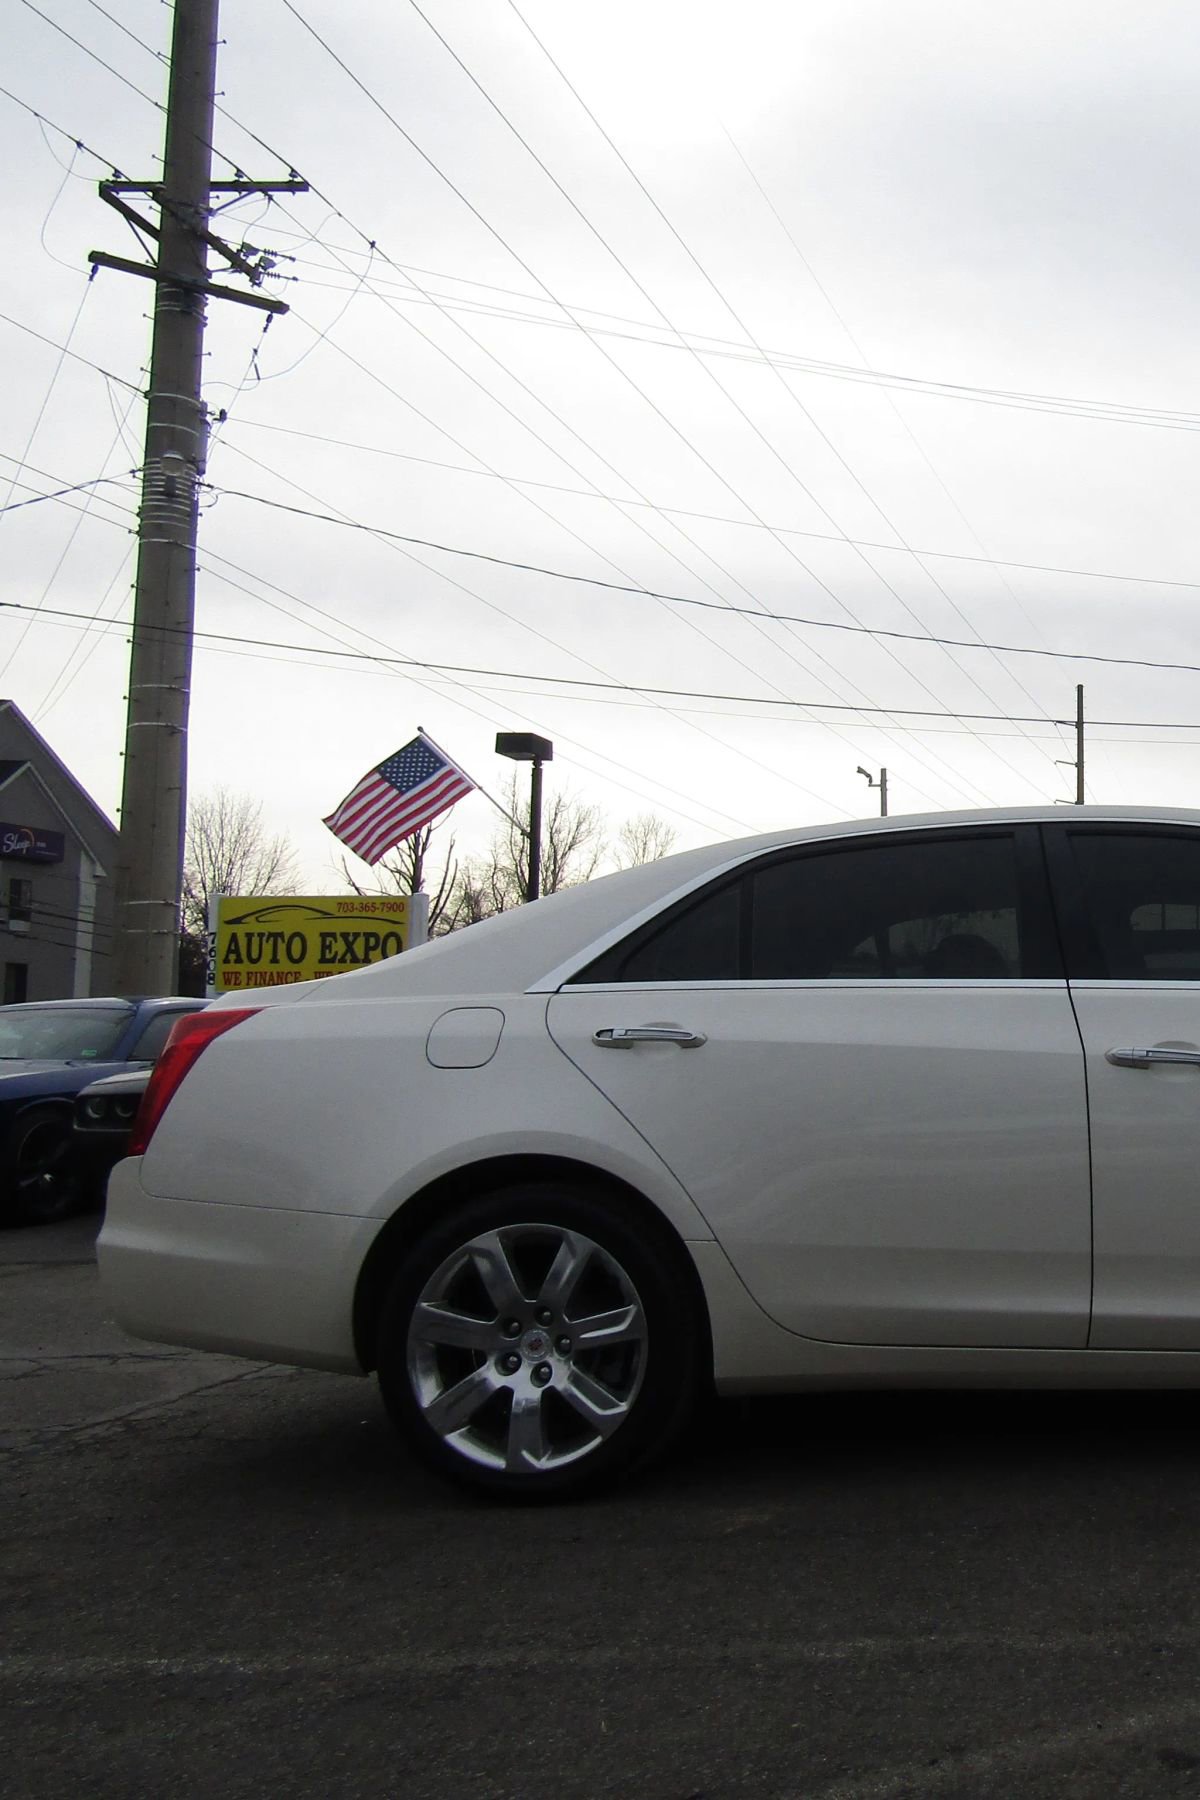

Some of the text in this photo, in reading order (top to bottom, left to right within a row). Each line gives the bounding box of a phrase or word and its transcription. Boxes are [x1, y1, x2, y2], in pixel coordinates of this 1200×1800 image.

[336, 902, 405, 913] 703-365-7900
[222, 931, 403, 964] AUTO EXPO
[222, 971, 242, 986] WE
[246, 971, 302, 986] FINANCE
